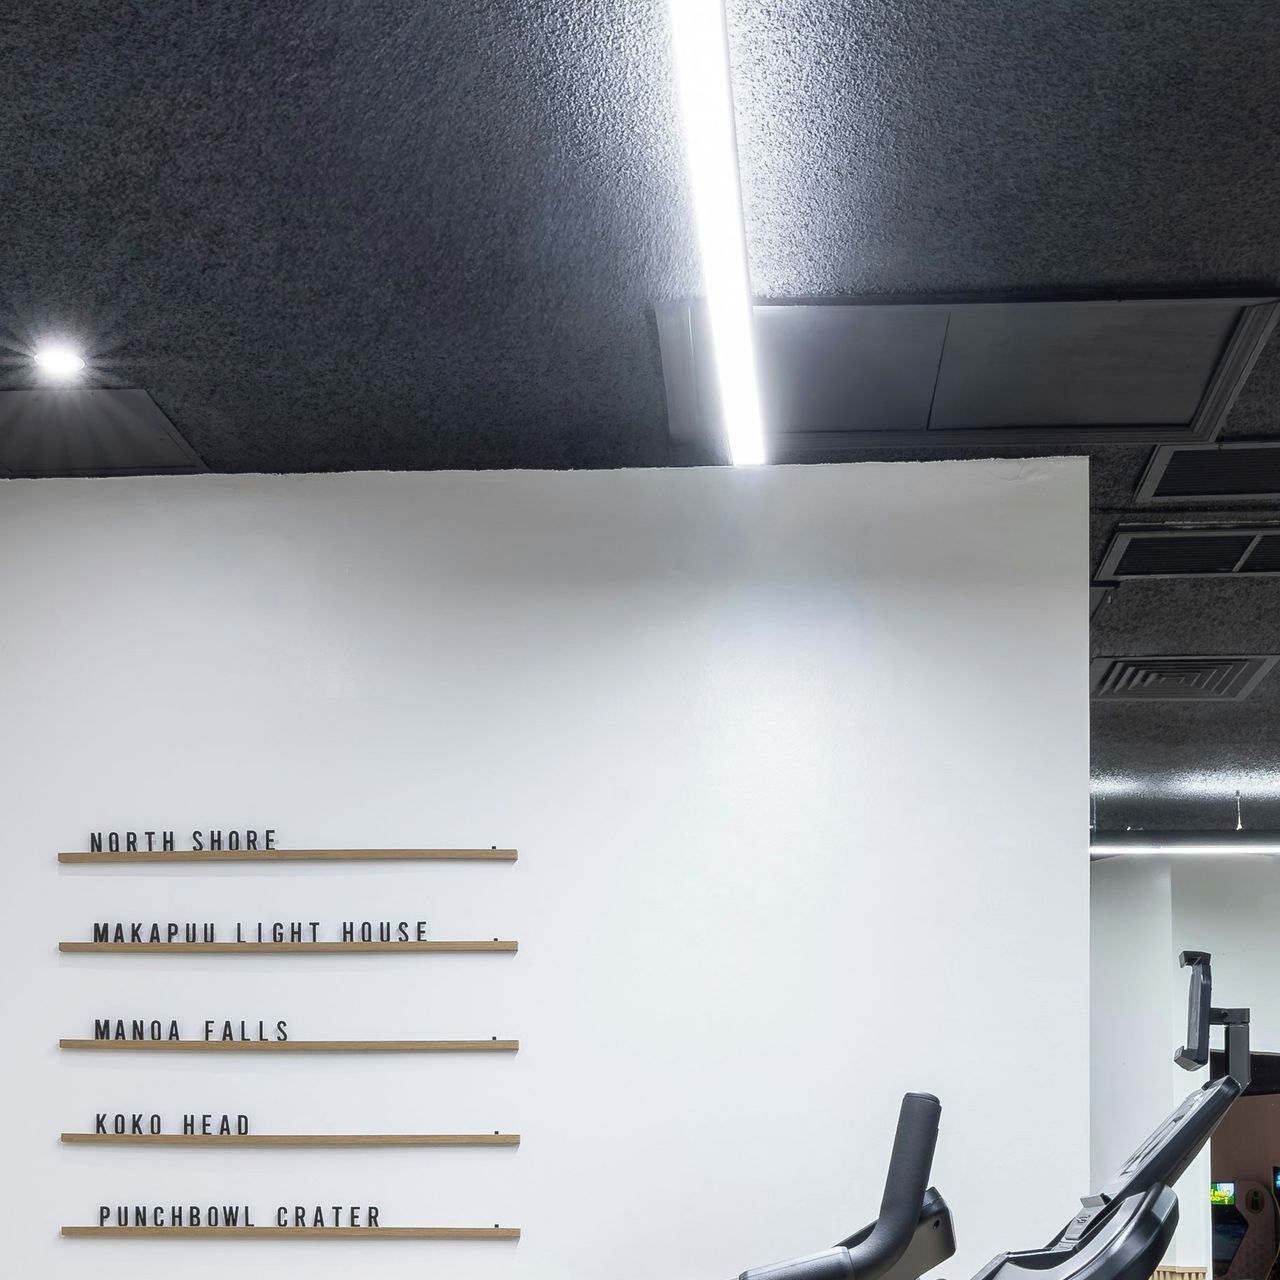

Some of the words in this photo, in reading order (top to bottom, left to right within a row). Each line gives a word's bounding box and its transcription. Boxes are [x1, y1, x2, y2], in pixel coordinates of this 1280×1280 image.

[90, 831, 174, 853] NORTH
[192, 829, 276, 852] SHORE
[93, 922, 214, 943] MAKAPUU
[237, 922, 320, 943] LIGHT
[342, 921, 427, 943] HOUSE
[94, 1019, 180, 1041] MANOA
[205, 1020, 288, 1042] FALLS
[95, 1113, 161, 1135] KOKO
[183, 1114, 249, 1136] HEAD
[99, 1206, 255, 1227] PUNCHBOWL
[277, 1206, 379, 1228] CRATER
